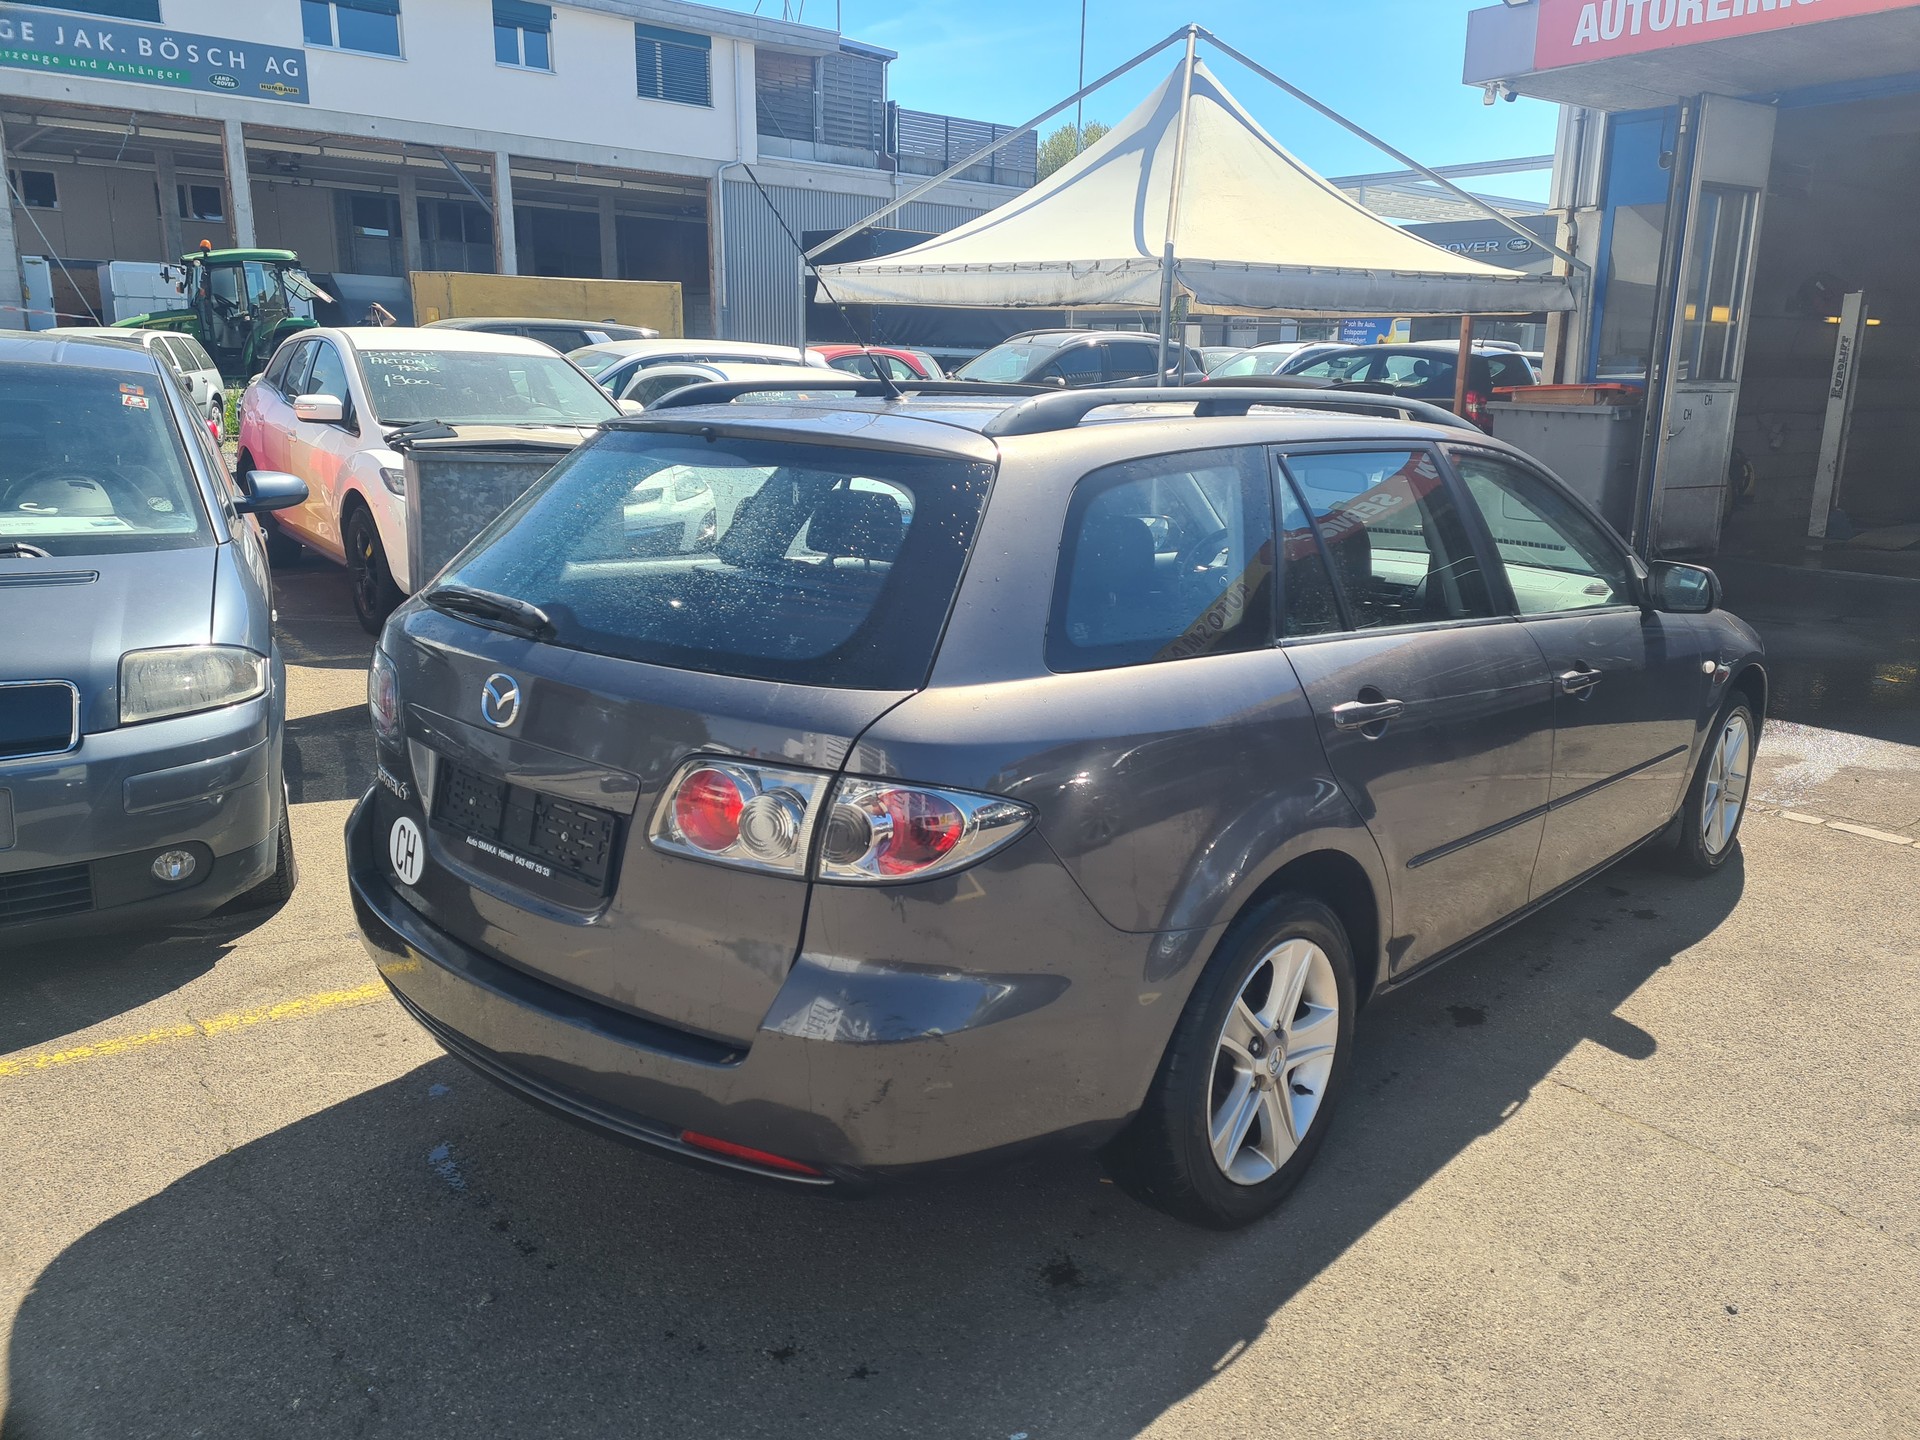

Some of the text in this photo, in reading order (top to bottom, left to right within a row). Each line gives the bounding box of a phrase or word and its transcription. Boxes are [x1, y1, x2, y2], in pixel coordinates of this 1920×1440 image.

[55, 26, 126, 54] JAK.
[138, 37, 245, 70] BÖSCH
[265, 56, 299, 77] AG
[69, 58, 97, 69] und
[107, 62, 181, 79] Anhänger
[260, 84, 298, 93] HUMBAUR
[1704, 394, 1713, 406] CH
[1683, 408, 1693, 421] CH
[396, 824, 416, 879] CH
[466, 836, 477, 847] Auto
[478, 841, 496, 855] SMAKA
[515, 856, 525, 867] 043
[525, 861, 535, 871] 497
[535, 864, 542, 874] 33
[542, 867, 550, 877] 33
